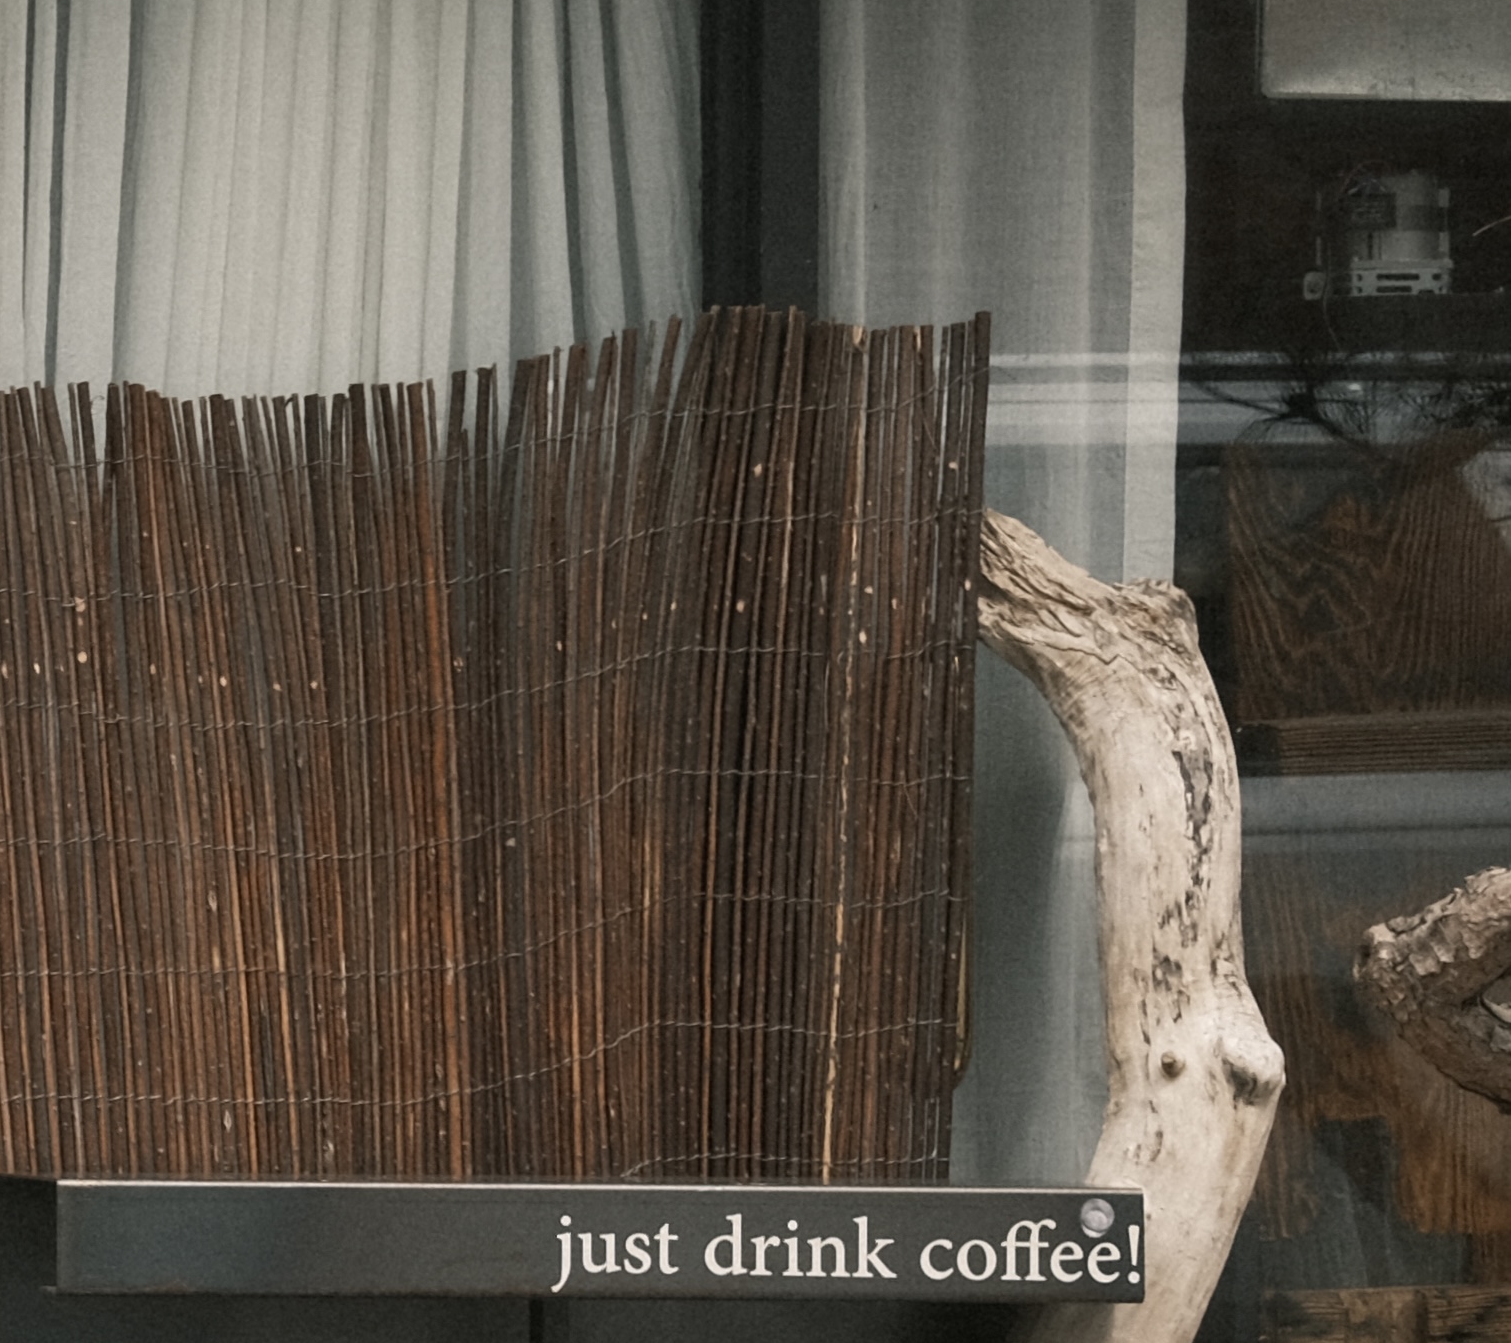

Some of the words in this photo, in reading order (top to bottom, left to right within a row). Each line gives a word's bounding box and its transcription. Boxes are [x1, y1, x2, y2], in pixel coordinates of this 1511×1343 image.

[550, 1214, 680, 1294] just
[703, 1212, 899, 1280] drink
[919, 1217, 1142, 1285] coffee!
